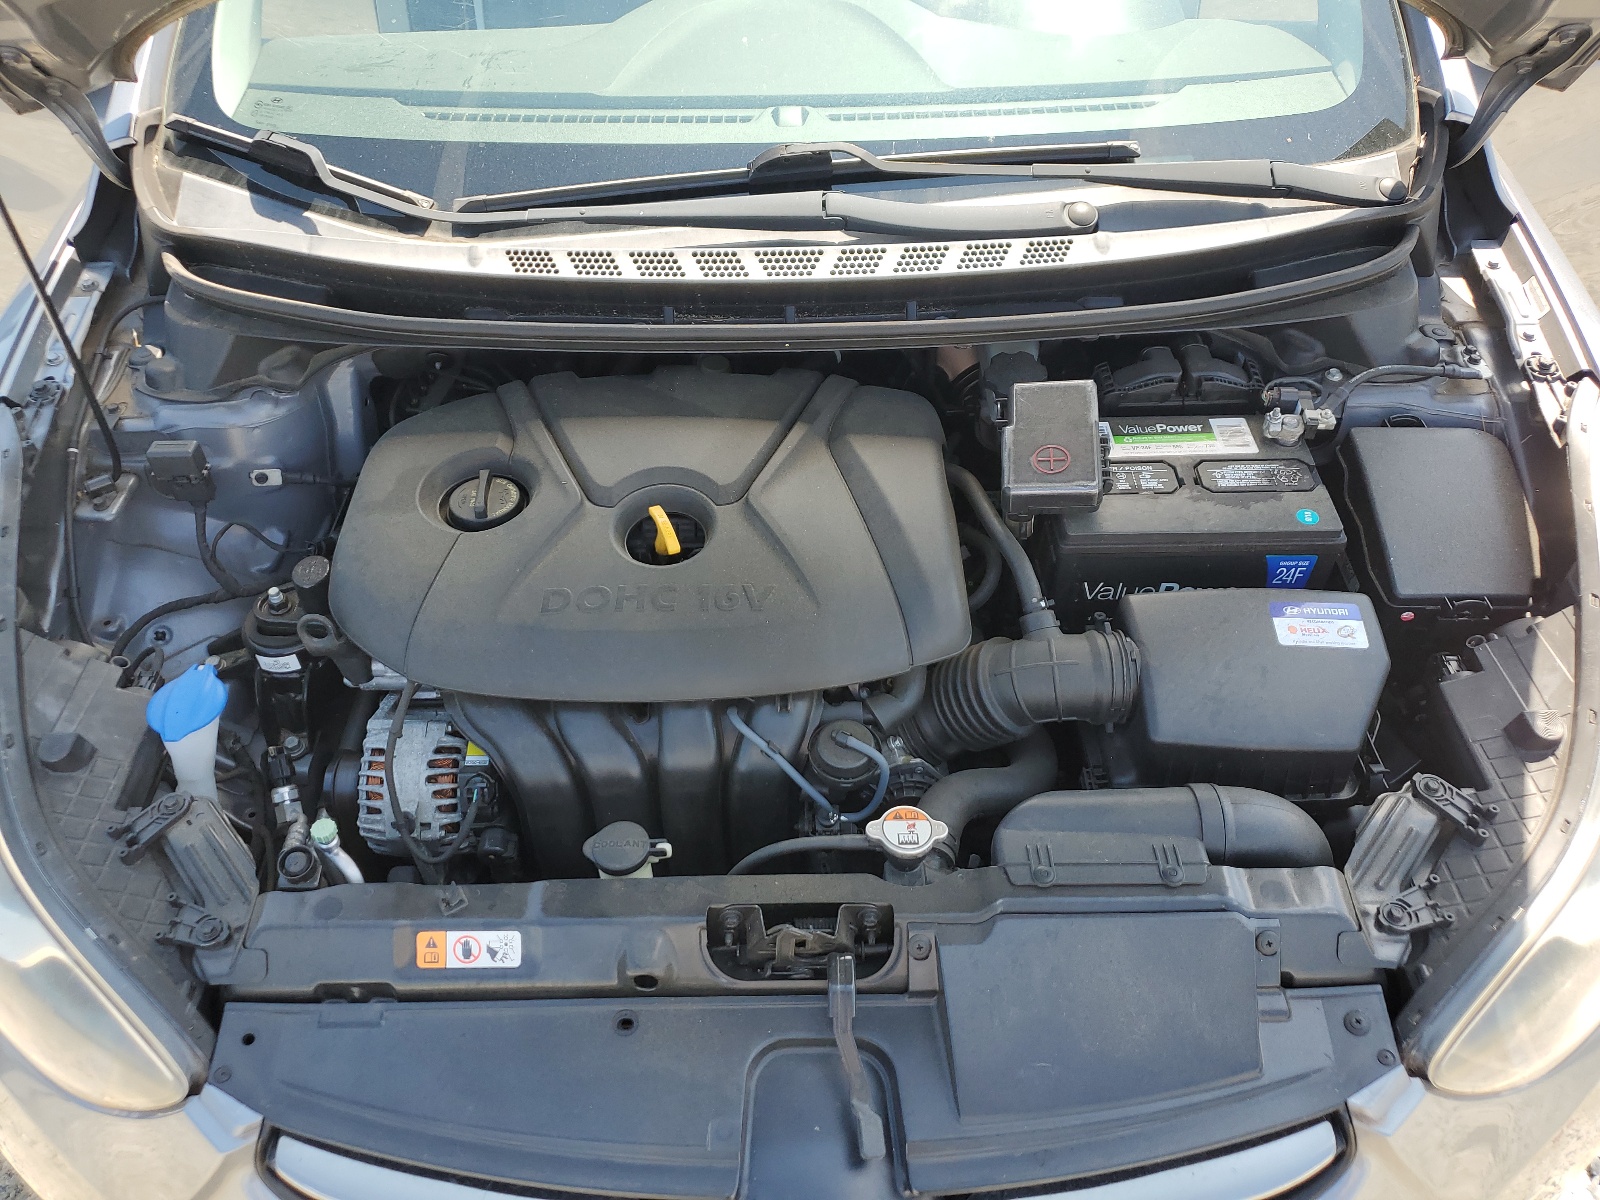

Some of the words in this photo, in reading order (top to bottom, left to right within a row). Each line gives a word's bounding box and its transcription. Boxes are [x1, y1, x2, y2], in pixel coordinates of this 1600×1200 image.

[1118, 423, 1204, 434] ValuePower
[1272, 567, 1307, 584] 24F
[540, 584, 679, 614] DOHC
[698, 583, 777, 612] 16V
[1303, 607, 1349, 616] HYUNDAI
[592, 840, 647, 849] COOLANT
